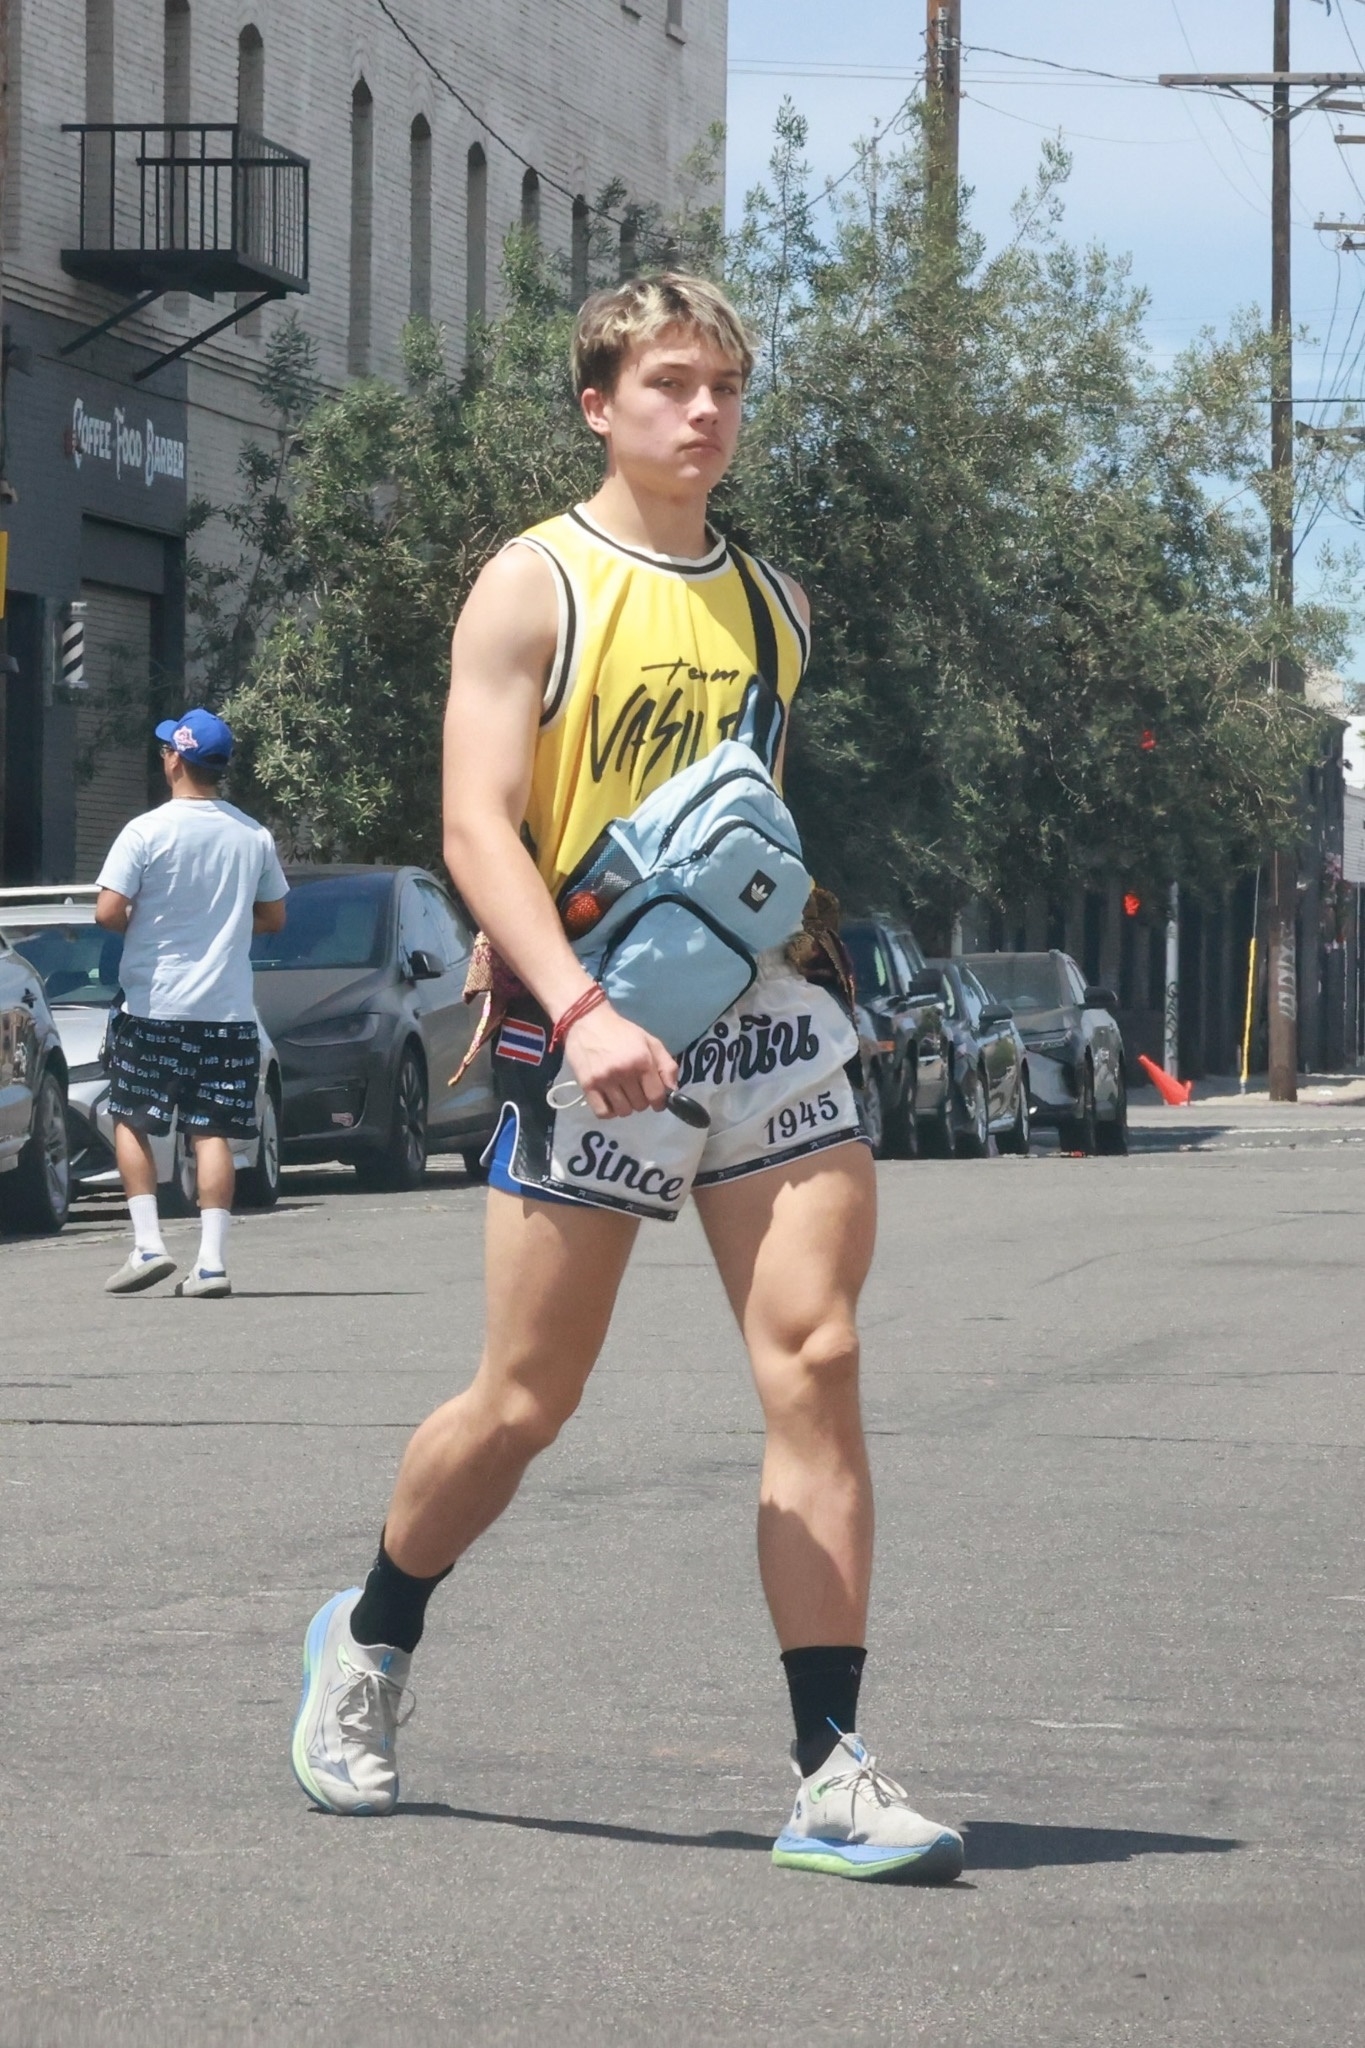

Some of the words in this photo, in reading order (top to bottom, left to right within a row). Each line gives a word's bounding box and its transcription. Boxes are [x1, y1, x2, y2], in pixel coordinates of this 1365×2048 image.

[72, 397, 112, 469] COFFEE
[114, 406, 142, 480] FOOD
[145, 418, 185, 487] BARBER
[641, 656, 740, 686] Team
[567, 1130, 684, 1202] Since
[764, 1090, 839, 1145] 1945
